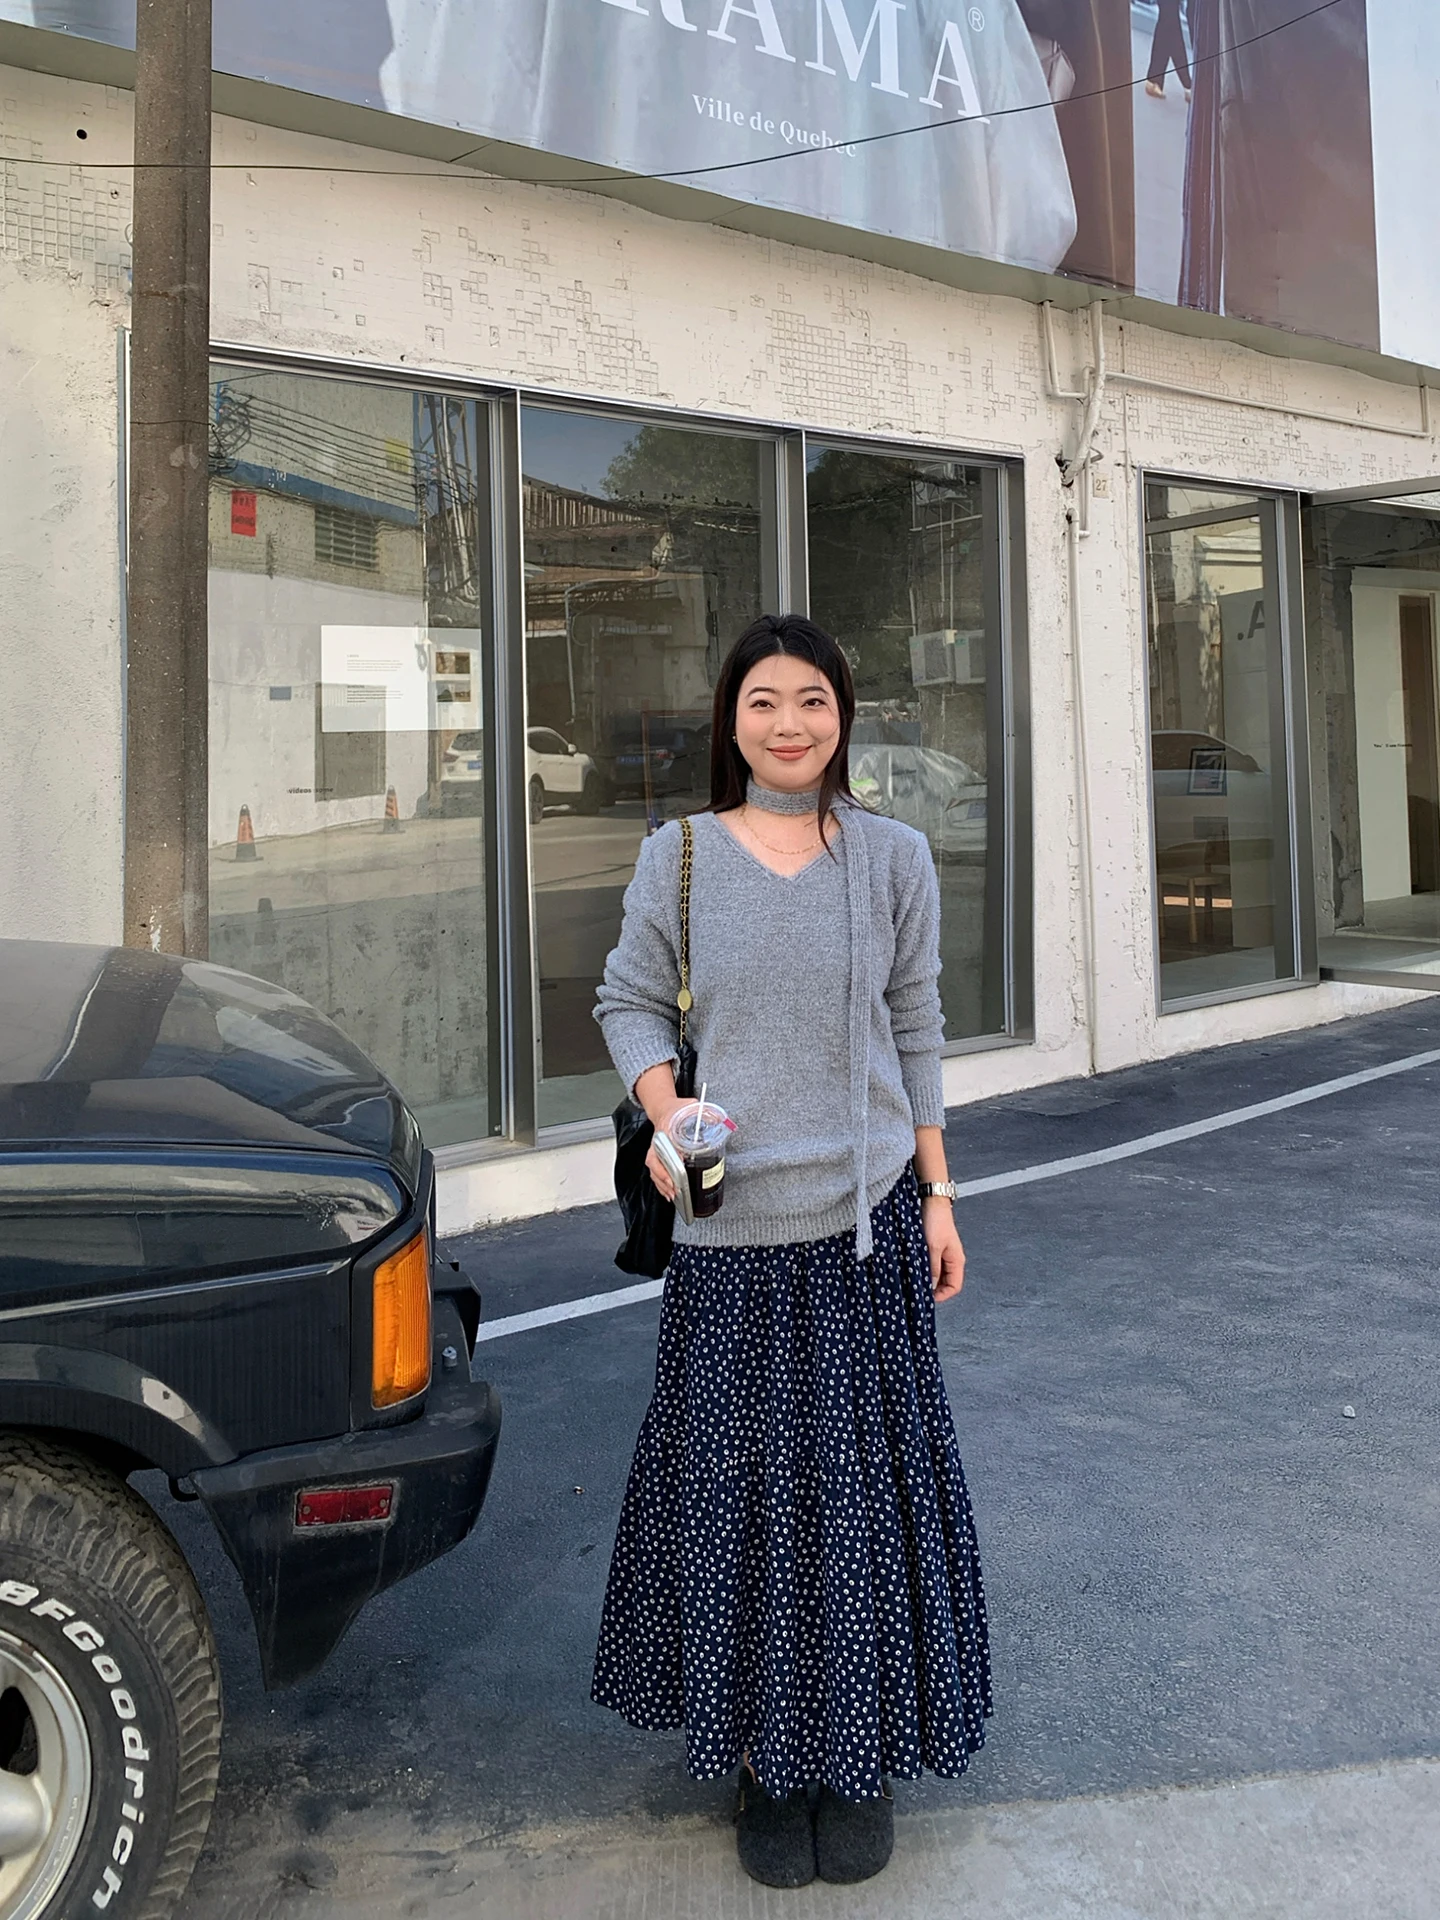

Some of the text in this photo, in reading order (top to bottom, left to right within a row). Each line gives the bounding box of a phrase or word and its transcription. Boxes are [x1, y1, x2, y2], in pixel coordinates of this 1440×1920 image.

[692, 93, 857, 158] Ville de Quebec
[1095, 478, 1107, 491] 27
[0, 1579, 150, 1909] BFGoodrich
